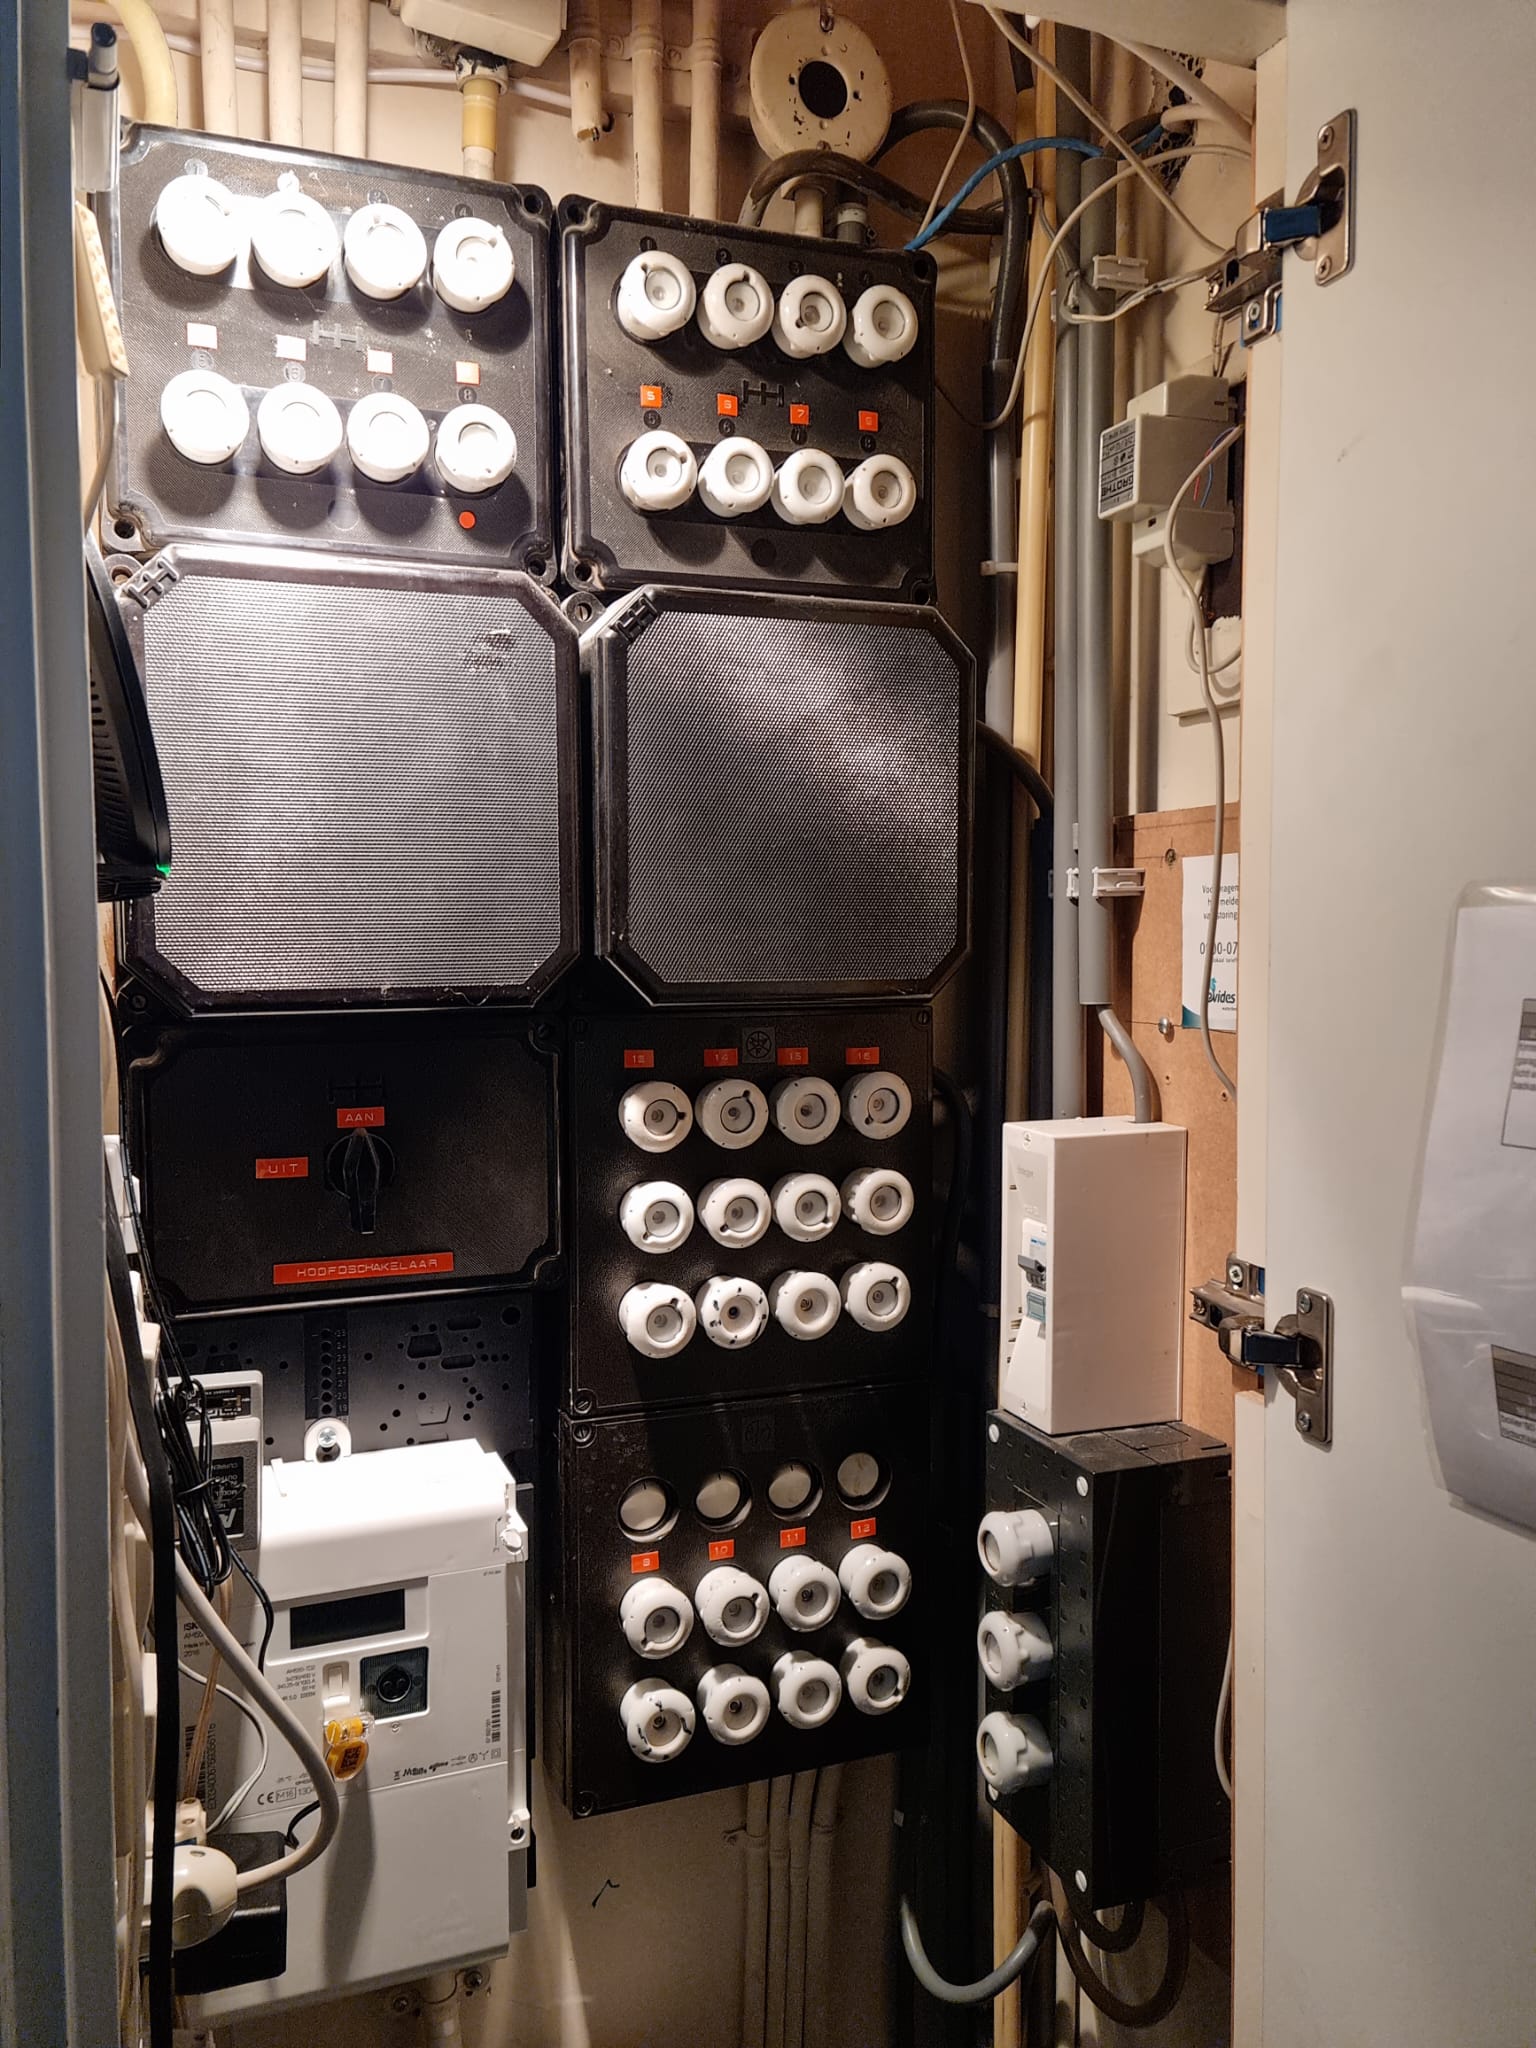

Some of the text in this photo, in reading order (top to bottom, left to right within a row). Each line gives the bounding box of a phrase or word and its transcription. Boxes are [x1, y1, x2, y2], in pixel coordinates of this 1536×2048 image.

[796, 409, 805, 418] 7
[1200, 941, 1239, 955] 000-07
[345, 1113, 374, 1122] AAN
[268, 1164, 298, 1174] UIT
[296, 1259, 438, 1277] HOOFDSCHAKELAAR
[786, 1534, 800, 1542] 11
[714, 1546, 728, 1555] 10
